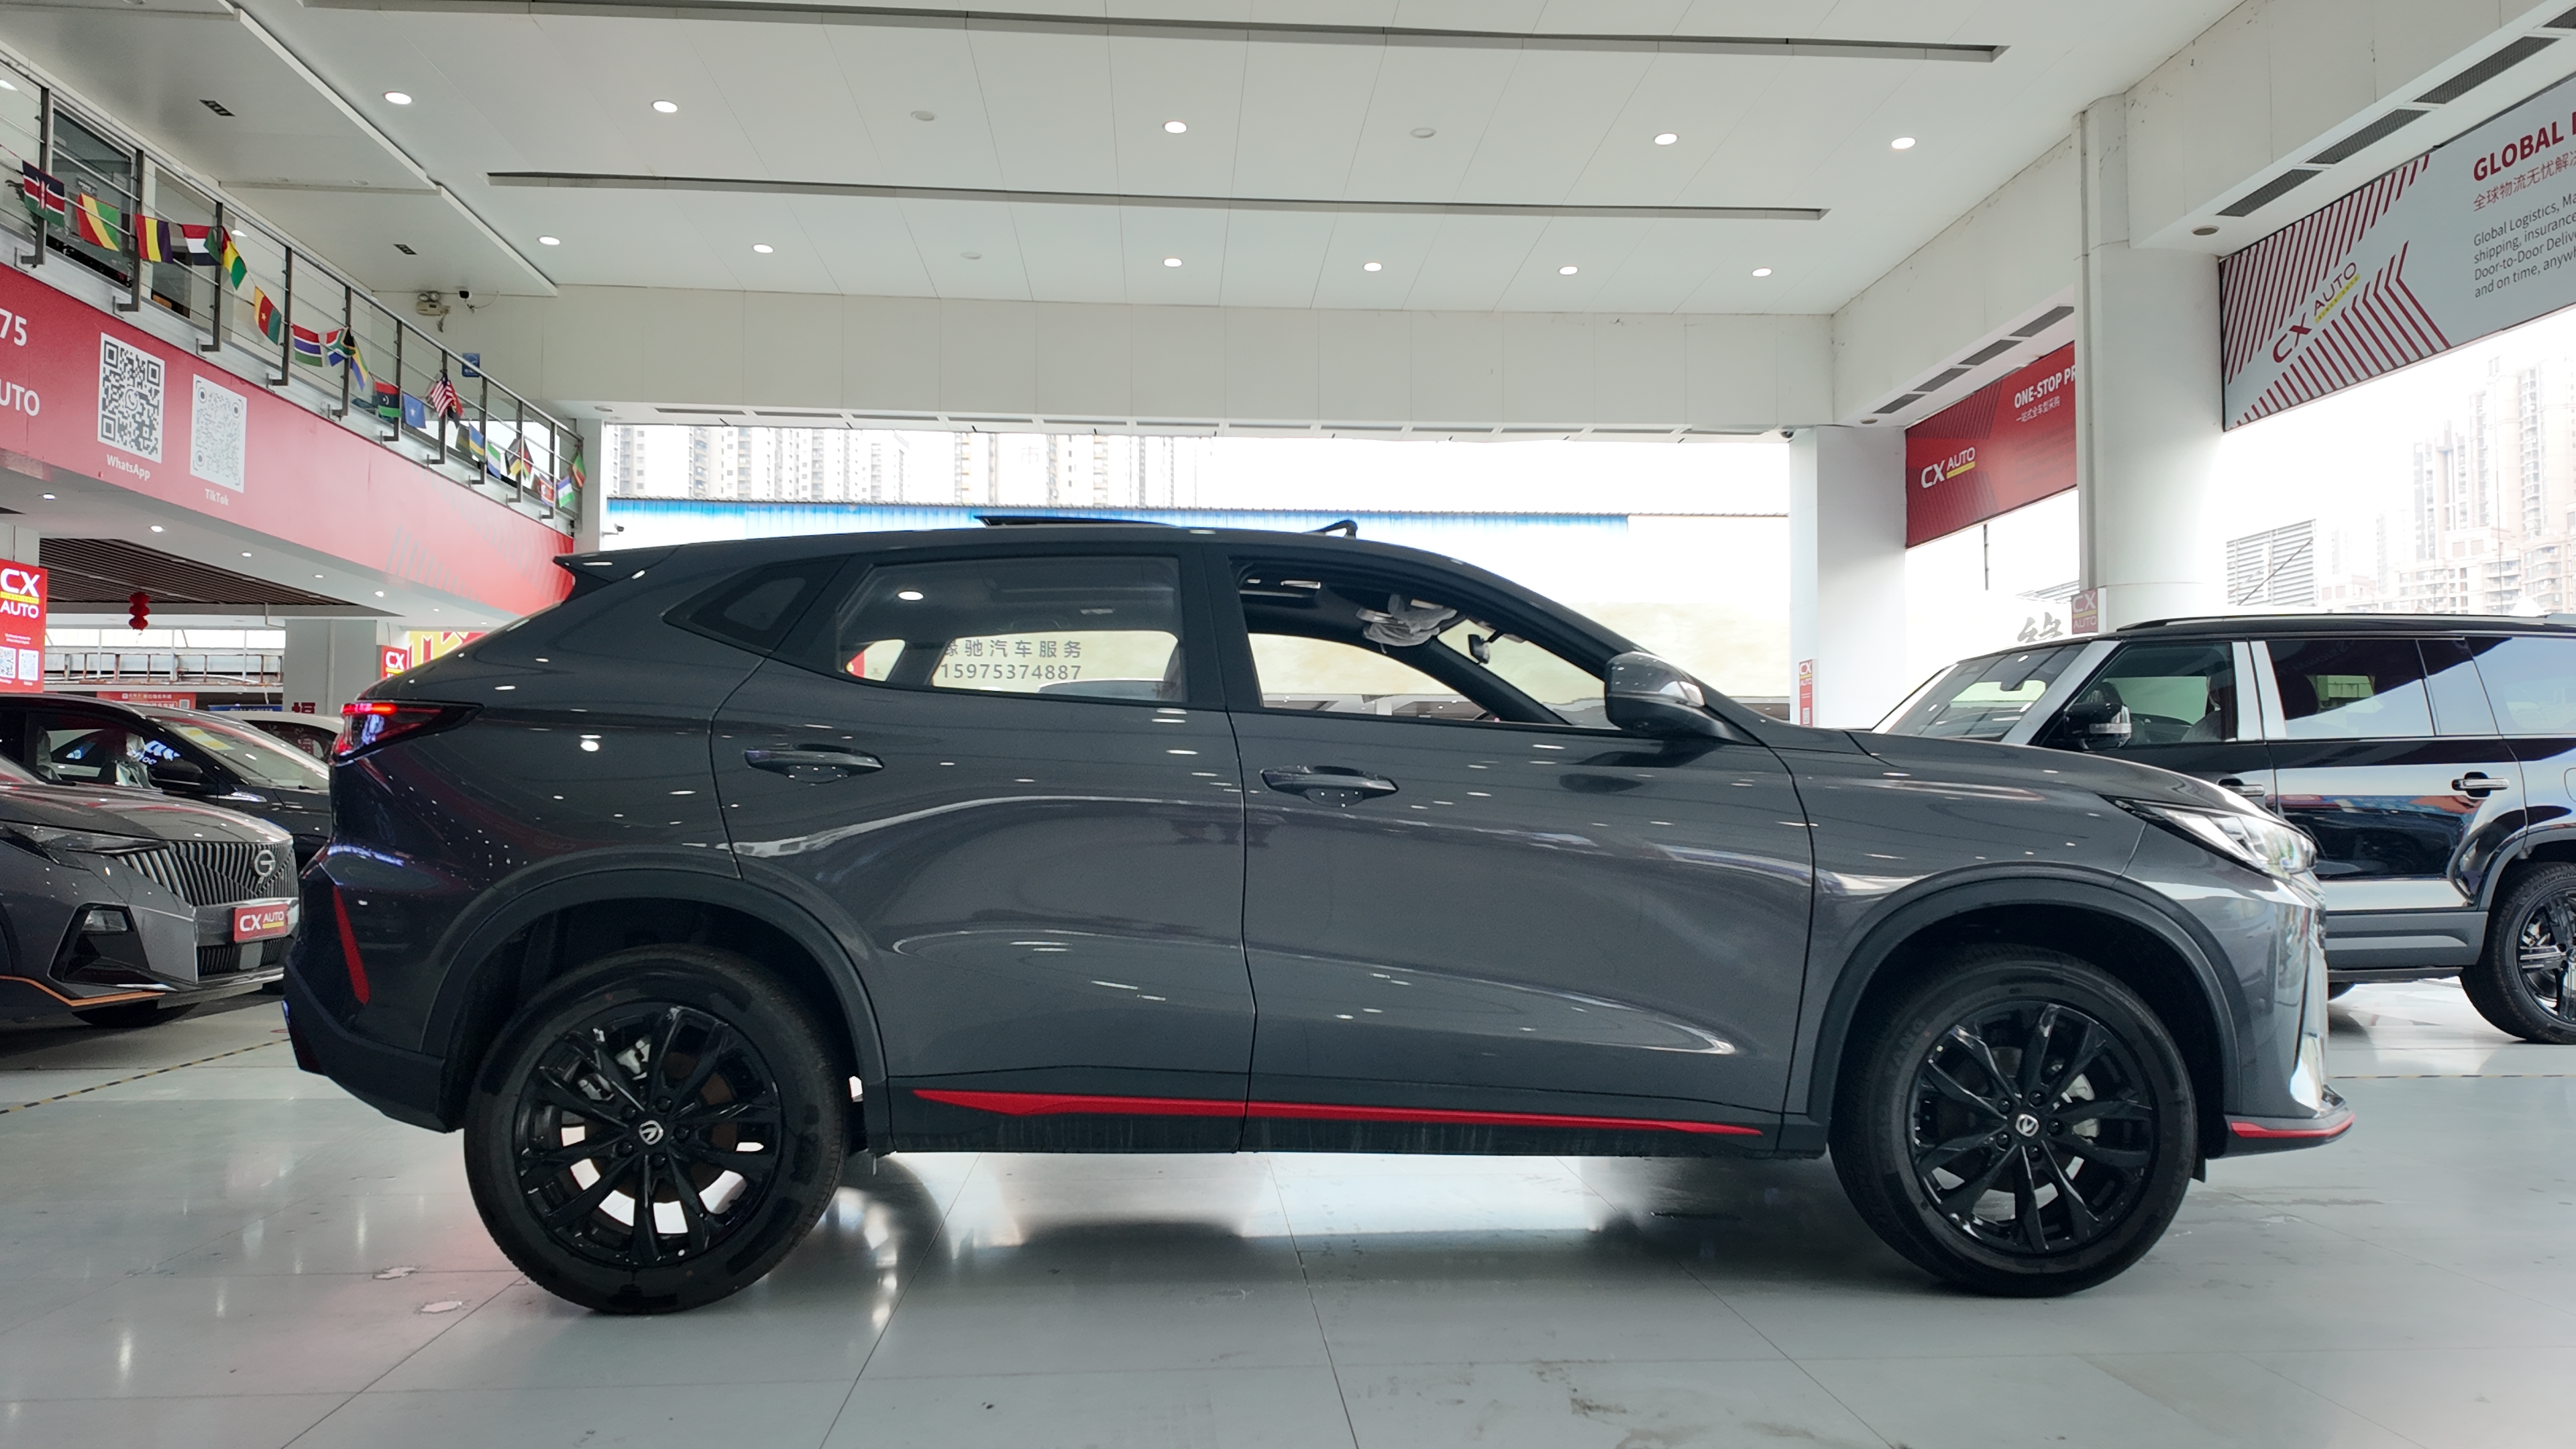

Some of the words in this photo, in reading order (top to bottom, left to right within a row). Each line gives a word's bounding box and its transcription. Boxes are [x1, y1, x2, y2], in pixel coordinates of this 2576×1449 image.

[2473, 121, 2564, 182] GLOBAL
[2473, 221, 2507, 247] Global
[2510, 203, 2560, 229] Logistics,
[2474, 237, 2522, 264] shipping,
[2475, 244, 2544, 281] Door-to-Door
[2475, 278, 2494, 298] and
[2496, 276, 2510, 289] on
[2513, 264, 2540, 283] time,
[2273, 312, 2312, 363] CX
[2314, 262, 2357, 317] AUTO
[0, 307, 28, 347] 75
[2015, 372, 2063, 409] ONE-STOP
[107, 453, 151, 481] WhatsApp
[1921, 460, 1945, 489] CX
[1947, 447, 1976, 471] AUTO
[205, 488, 229, 506] TikTok
[0, 568, 40, 598] CX
[0, 600, 40, 619] AUTO
[2072, 592, 2096, 613] CX
[2073, 616, 2097, 629] AUTO
[386, 651, 405, 669] CX
[941, 663, 1081, 680] 15975374887
[1799, 661, 1812, 676] CX
[239, 914, 262, 932] CX
[262, 911, 285, 923] AUTO
